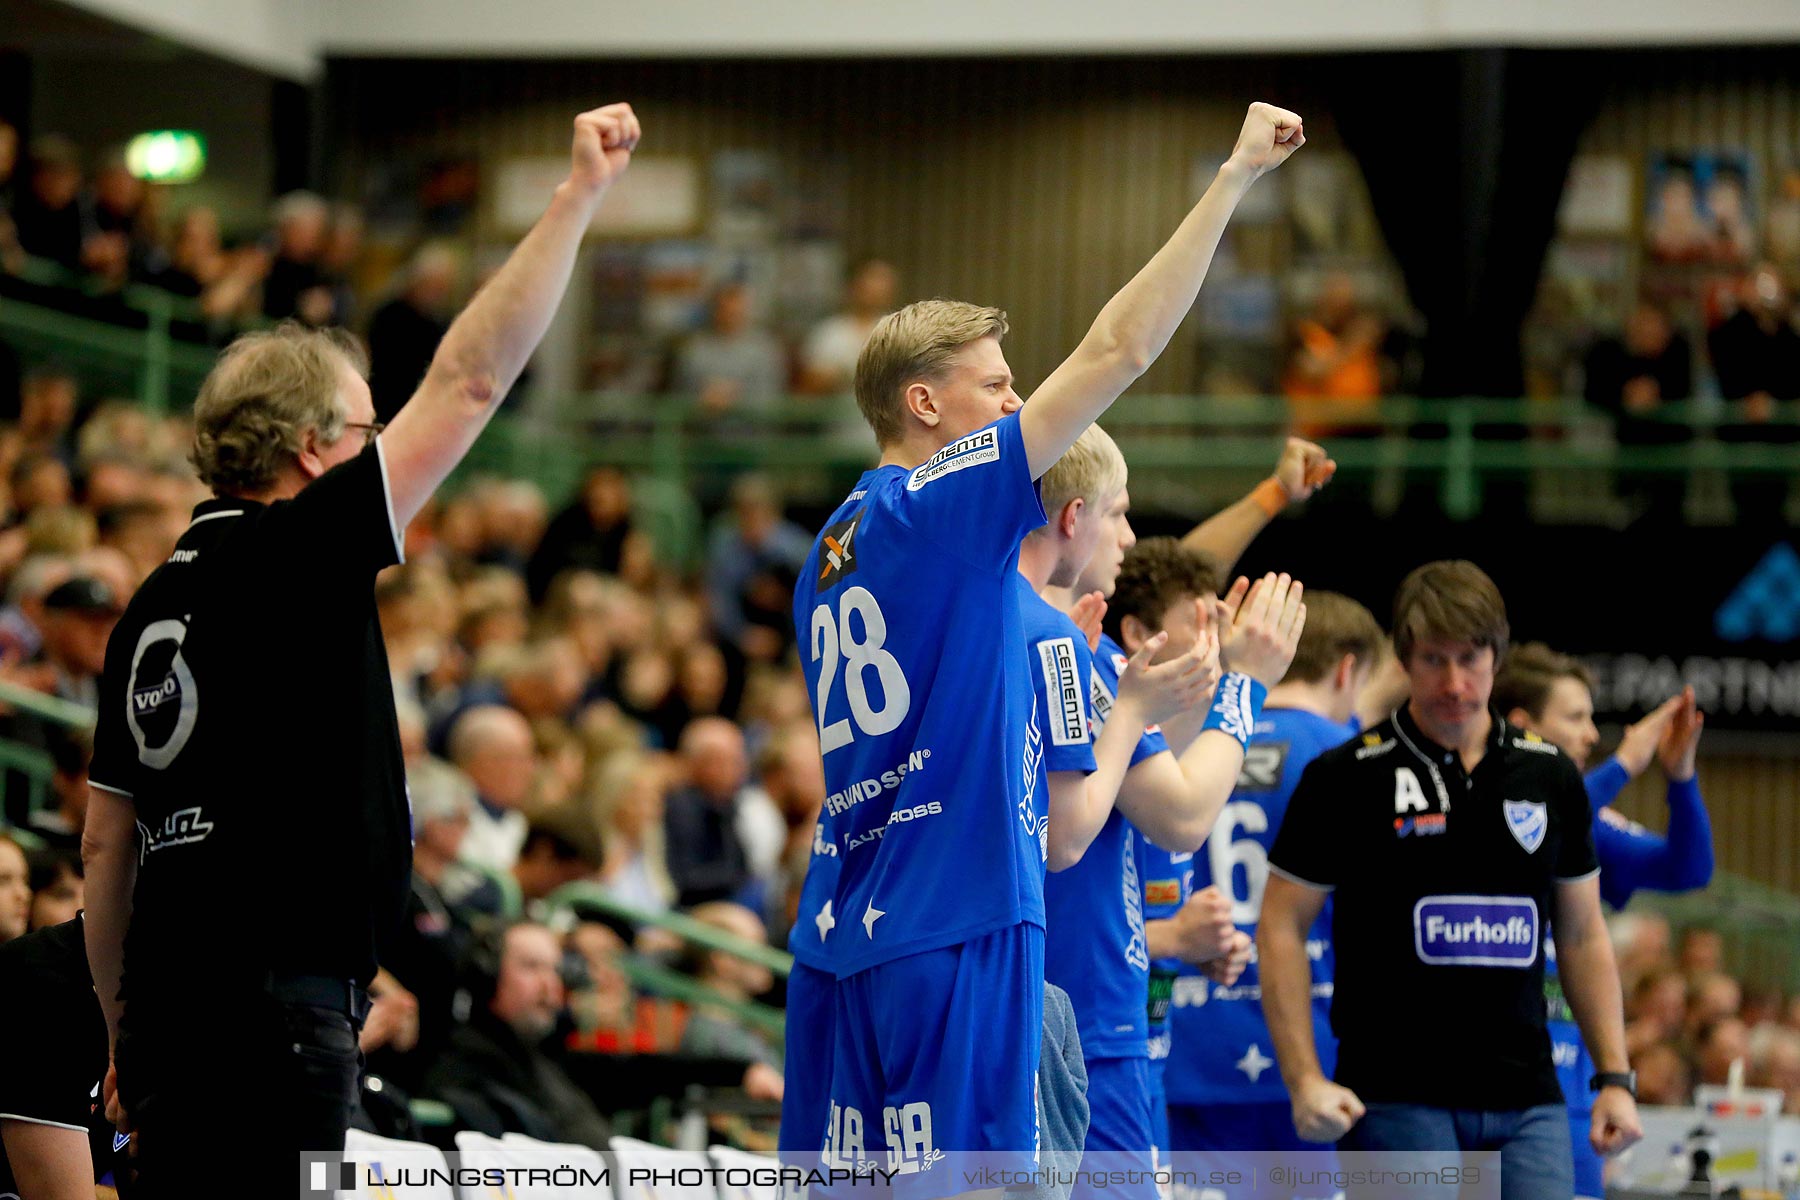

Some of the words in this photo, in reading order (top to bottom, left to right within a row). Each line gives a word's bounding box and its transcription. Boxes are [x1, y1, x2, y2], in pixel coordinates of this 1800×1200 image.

[134, 677, 177, 710] VOO
[811, 586, 911, 756] 28
[1056, 643, 1083, 739] CEMENTA
[1394, 766, 1430, 814] A
[1207, 801, 1270, 925] 6
[1425, 914, 1532, 946] Furhoffs
